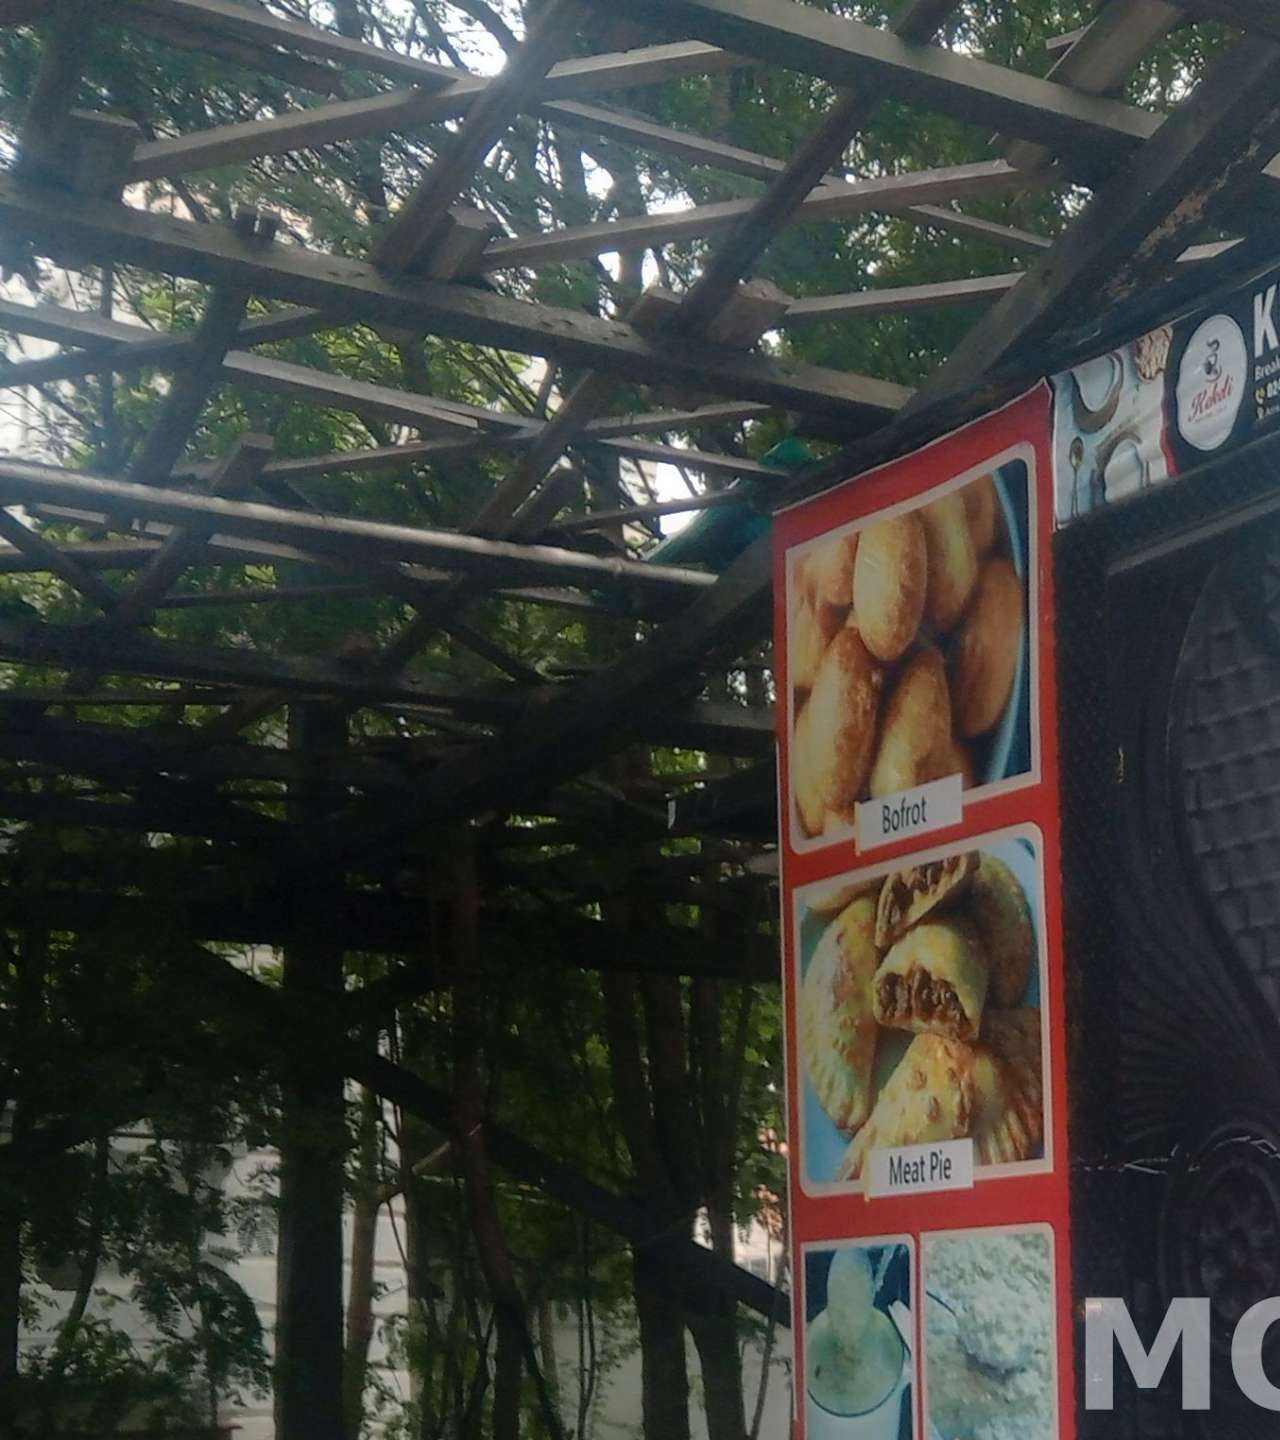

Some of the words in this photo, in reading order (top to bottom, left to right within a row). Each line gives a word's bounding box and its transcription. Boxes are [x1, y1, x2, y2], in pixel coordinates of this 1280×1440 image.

[881, 796, 928, 834] Bofrot
[889, 1155, 926, 1186] Meat
[929, 1150, 952, 1181] Pie
